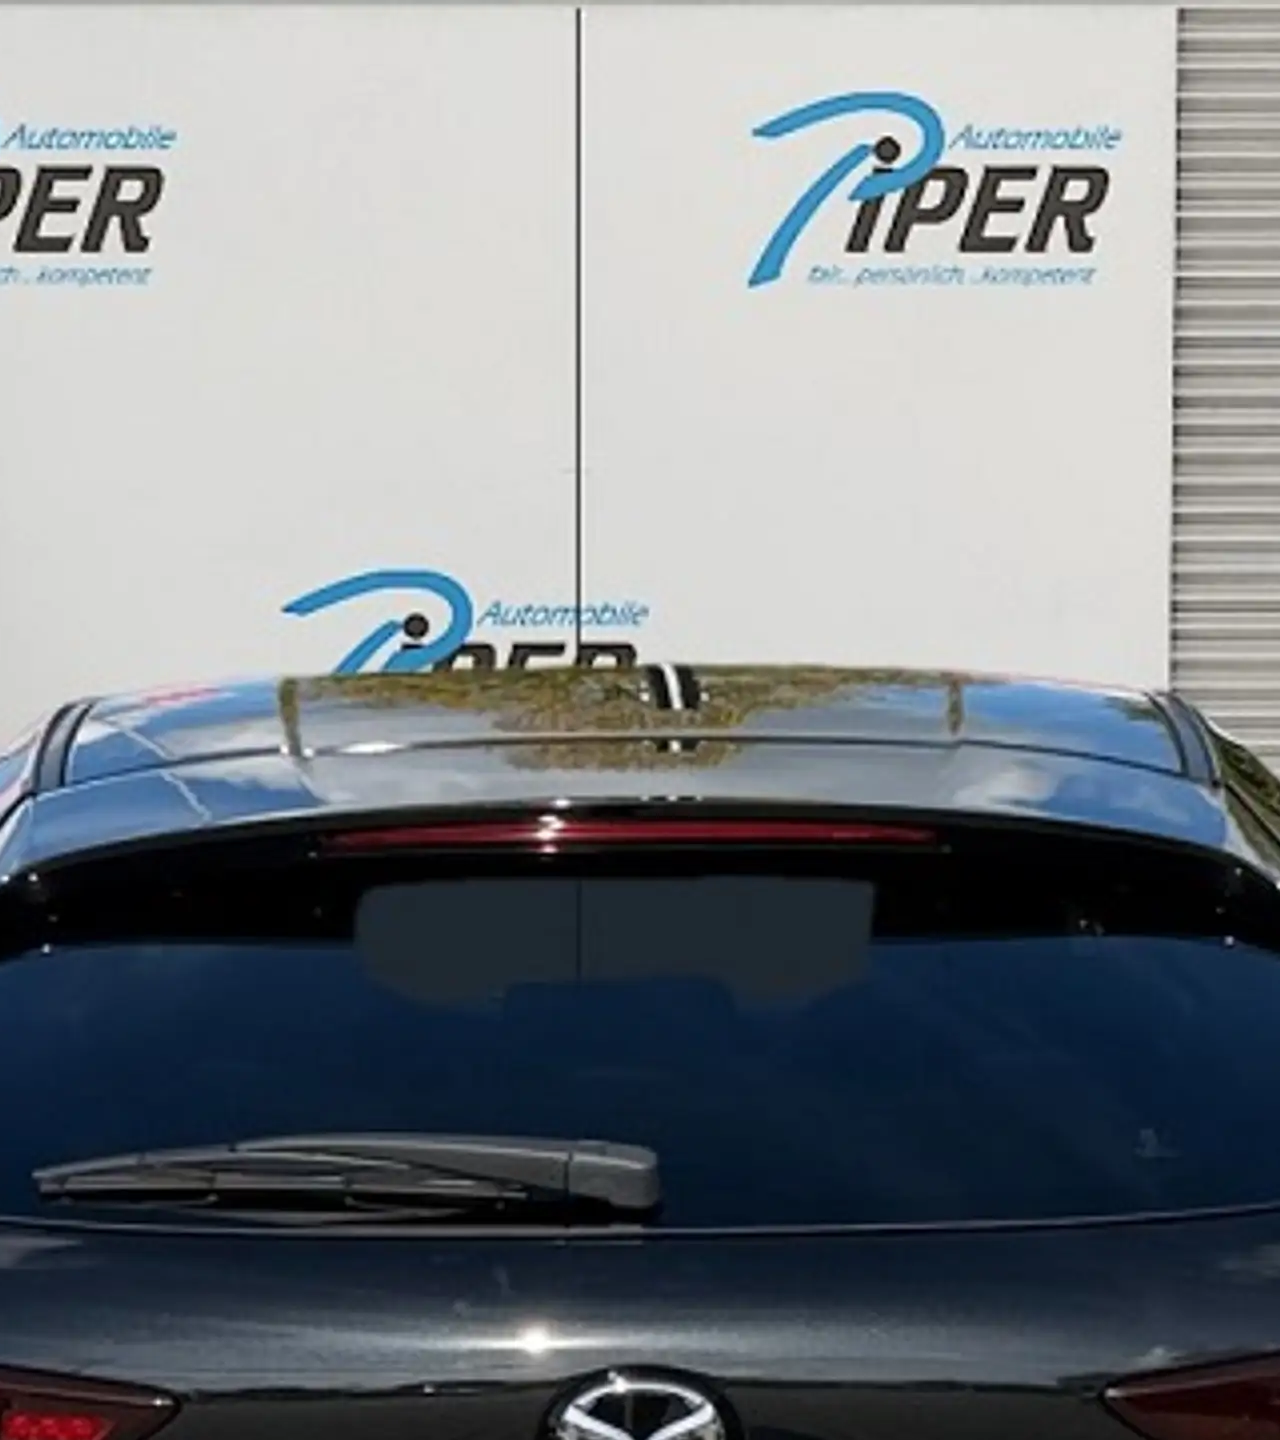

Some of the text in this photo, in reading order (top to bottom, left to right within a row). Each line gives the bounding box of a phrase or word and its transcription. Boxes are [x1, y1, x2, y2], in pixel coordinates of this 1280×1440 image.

[2, 123, 178, 151] Automobile
[948, 123, 1122, 151] Automobile
[476, 599, 650, 628] Automobile
